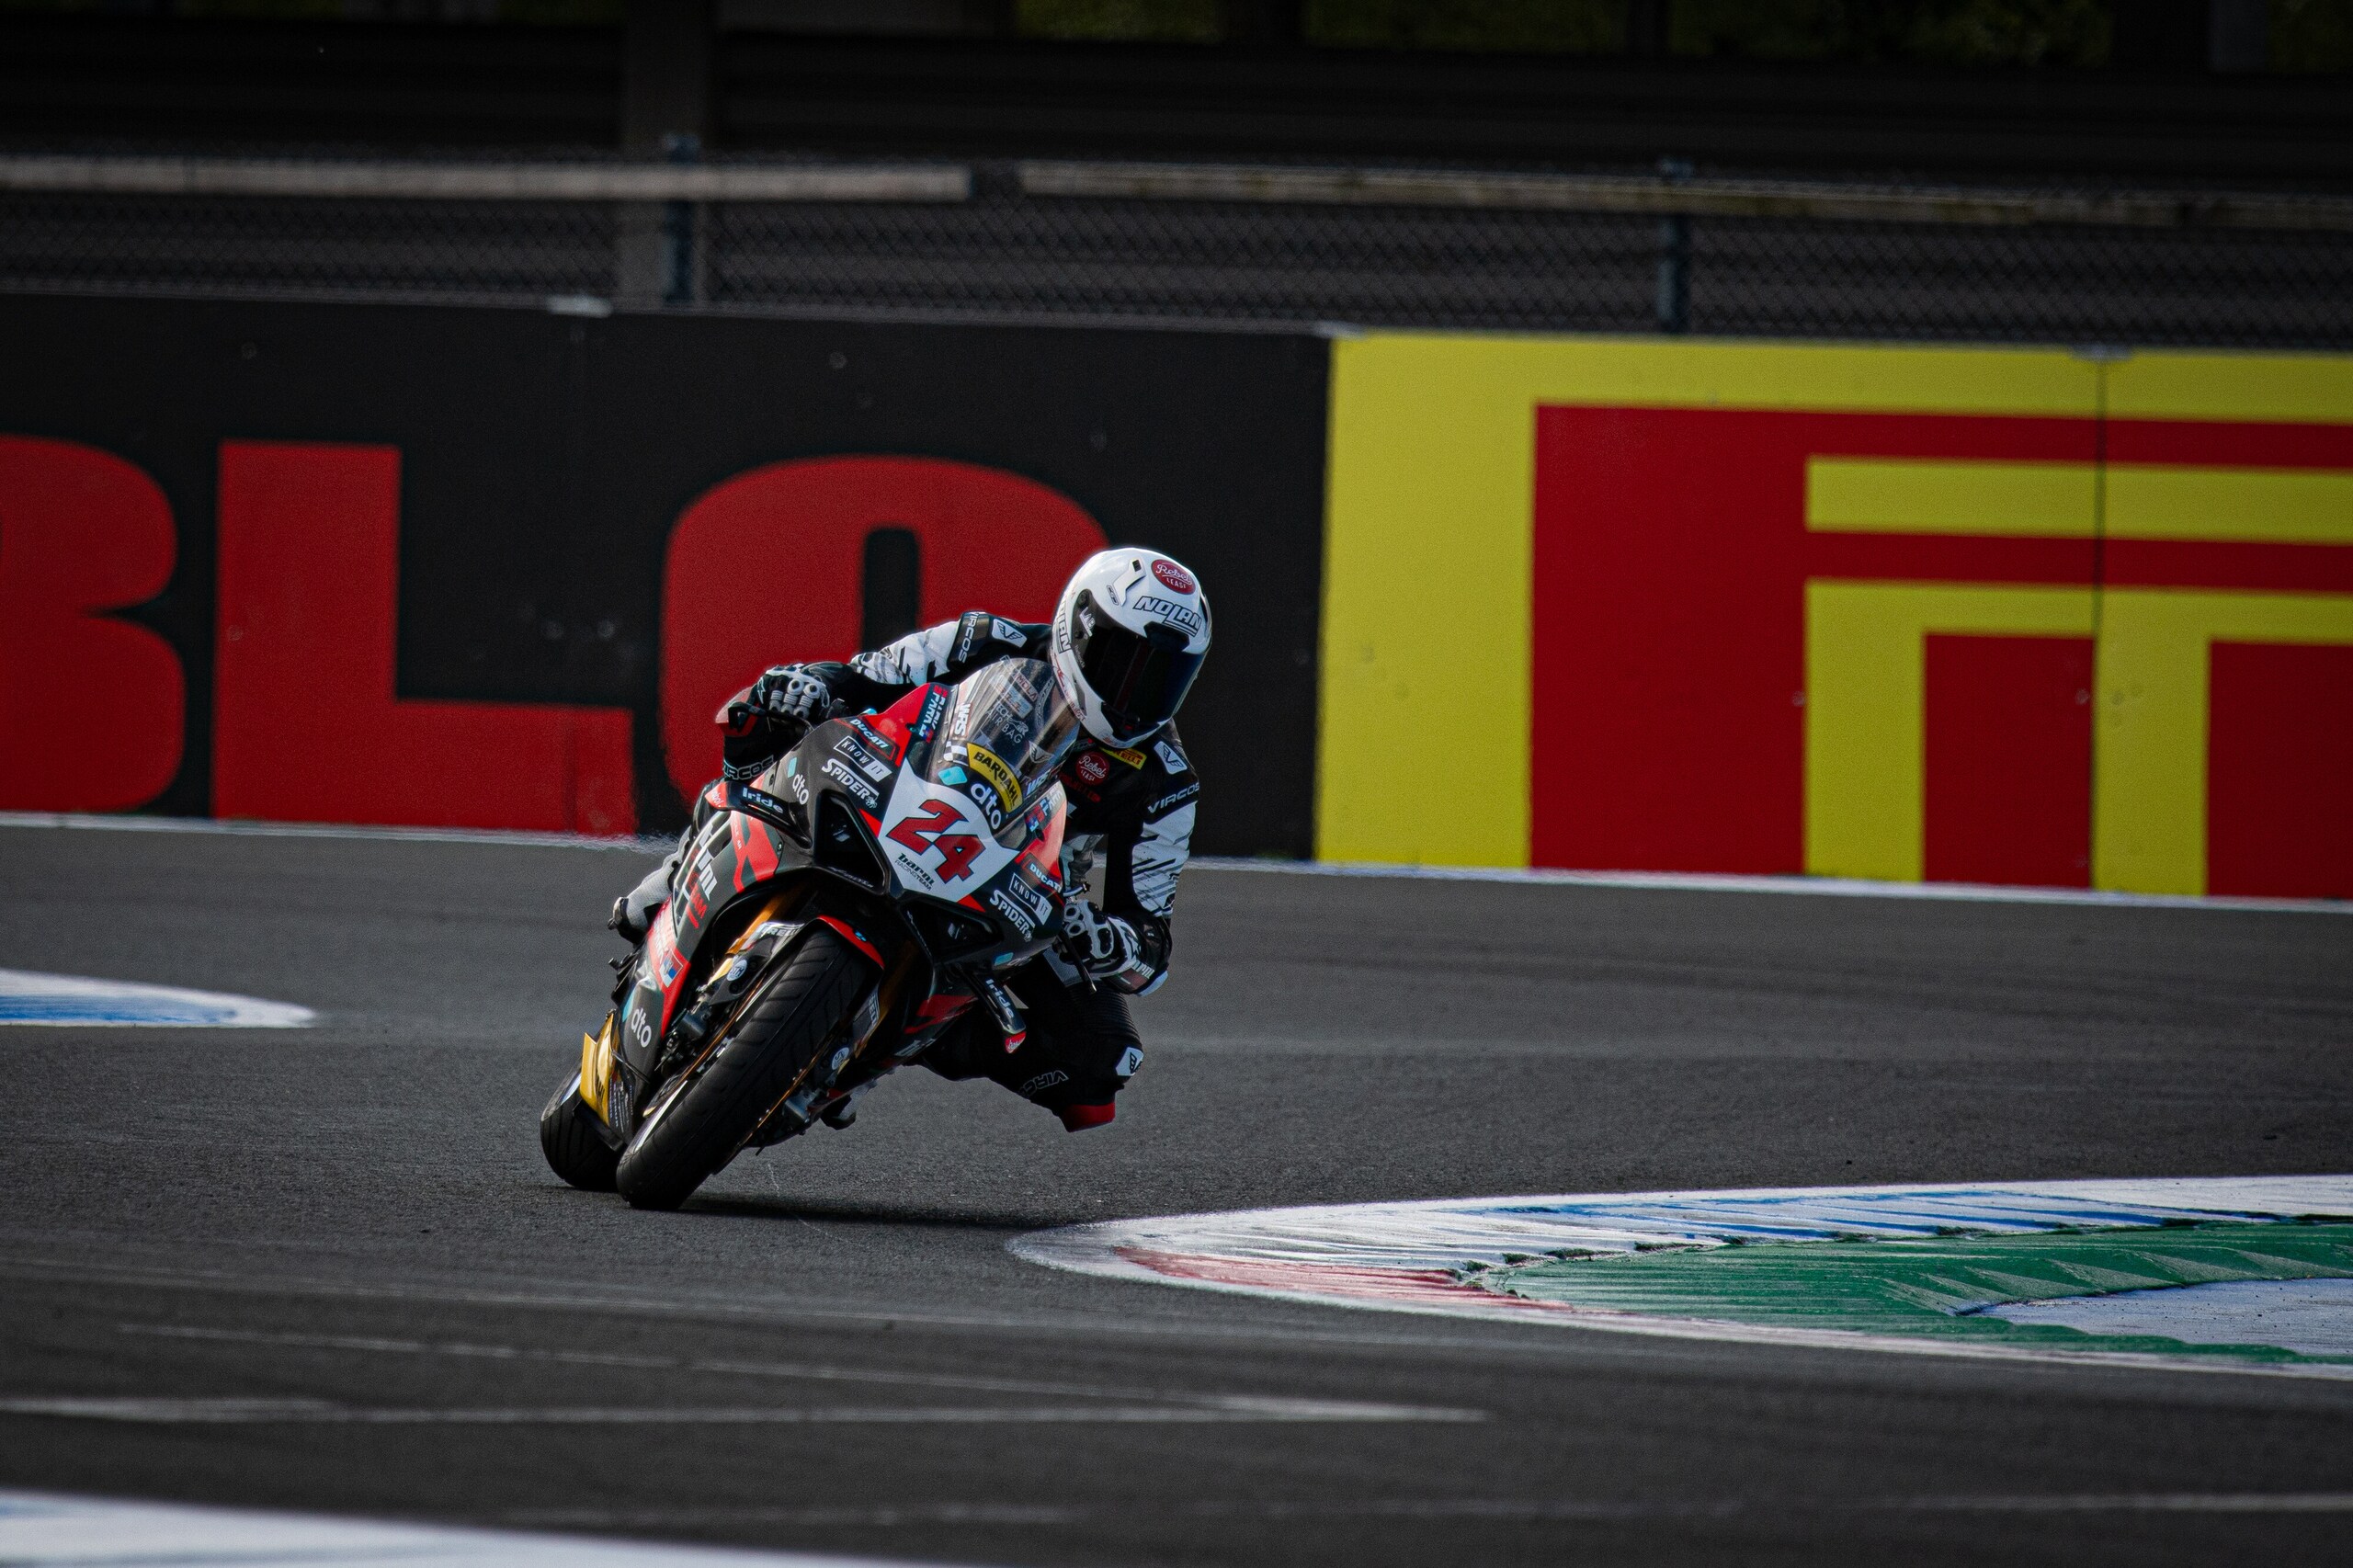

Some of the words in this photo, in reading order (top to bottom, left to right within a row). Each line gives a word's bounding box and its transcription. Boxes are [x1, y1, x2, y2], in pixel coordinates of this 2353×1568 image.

[1155, 563, 1193, 586] Rebel
[1165, 576, 1188, 589] LEASE
[1132, 595, 1203, 633] NOLAN
[849, 718, 890, 750] DUCATI
[1001, 722, 1023, 744] BAG
[840, 740, 870, 766] KNOW
[870, 761, 884, 776] IT
[1078, 755, 1107, 778] Rebel
[791, 774, 810, 805] dto
[822, 758, 879, 802] SPIDER
[973, 750, 1018, 807] BARDAHL
[742, 787, 784, 813] Iride
[970, 782, 1002, 830] dto
[1147, 781, 1200, 814] VIRCOS
[885, 798, 986, 885] 24
[1029, 862, 1062, 893] DUCATI
[989, 889, 1035, 936] SPIDER
[1012, 880, 1038, 904] KNOW
[1040, 900, 1049, 915] IT
[631, 1007, 653, 1048] dto
